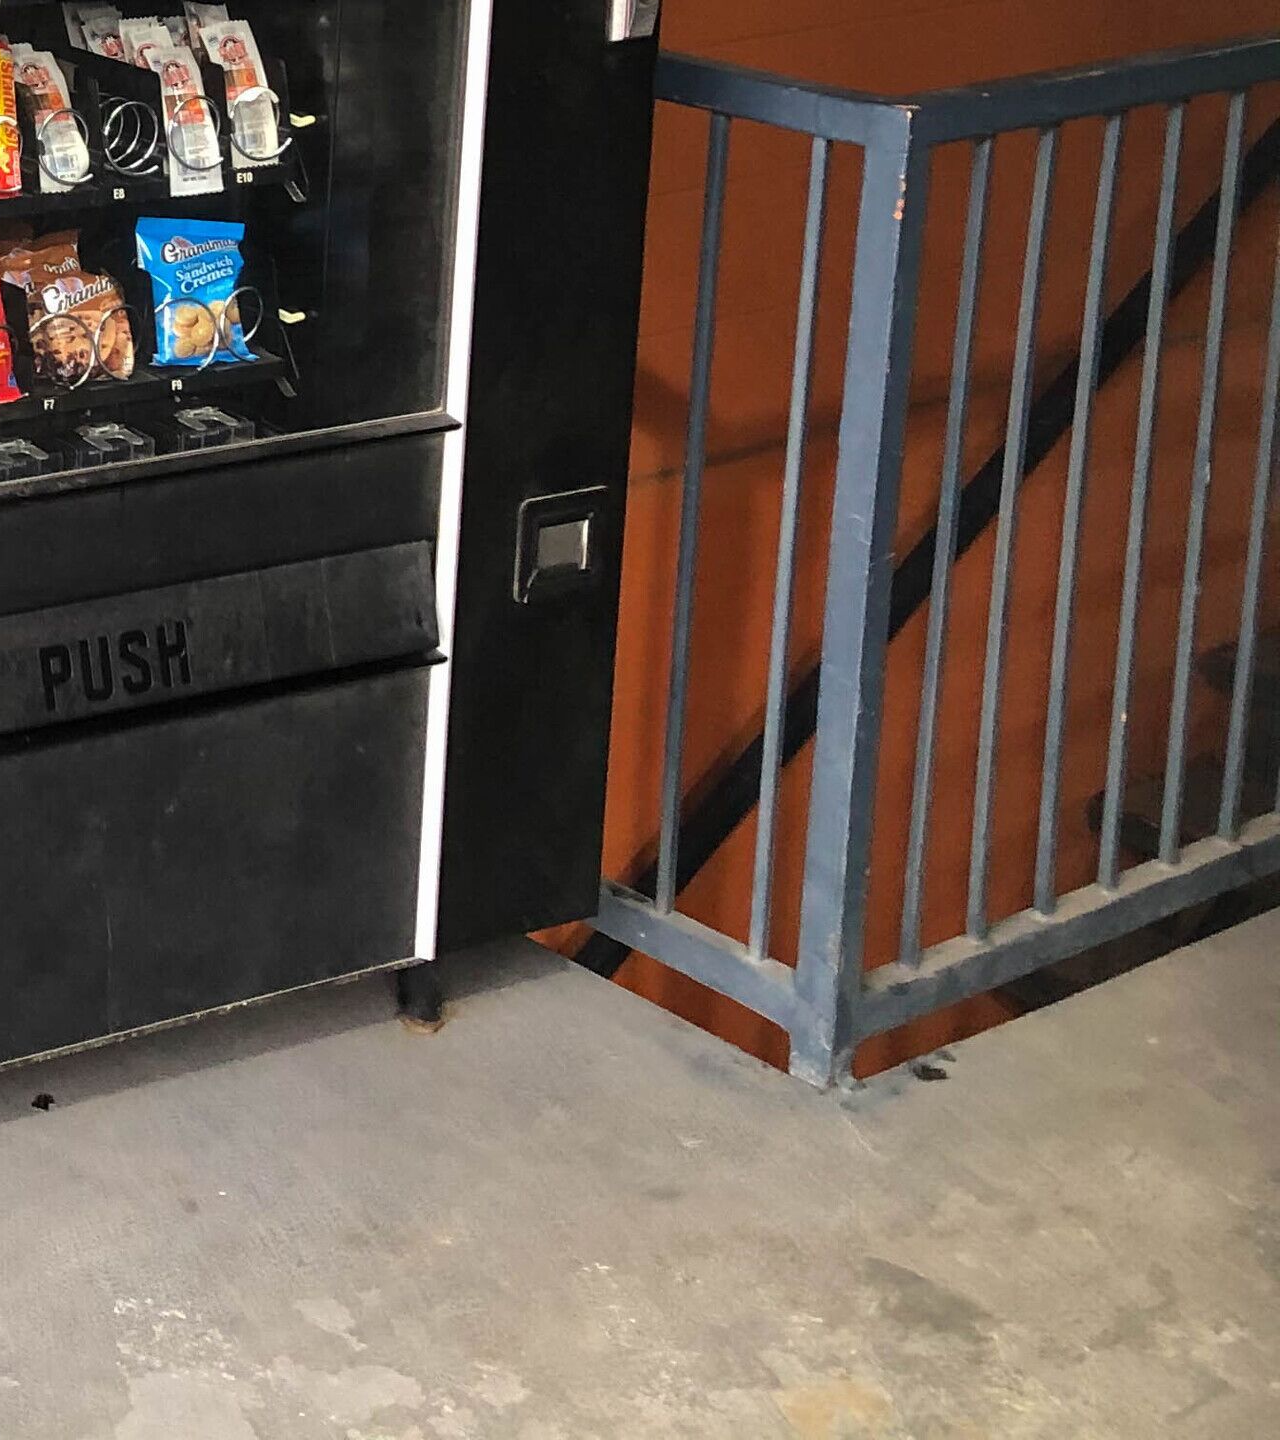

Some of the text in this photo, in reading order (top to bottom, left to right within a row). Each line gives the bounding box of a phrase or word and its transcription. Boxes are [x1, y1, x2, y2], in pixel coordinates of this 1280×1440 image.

[236, 172, 254, 183] E10
[113, 188, 126, 200] E8
[175, 255, 234, 282] Sandwich
[180, 267, 234, 293] Cremes
[171, 379, 183, 391] F9
[43, 399, 55, 411] F7
[38, 618, 193, 710] PUSH
